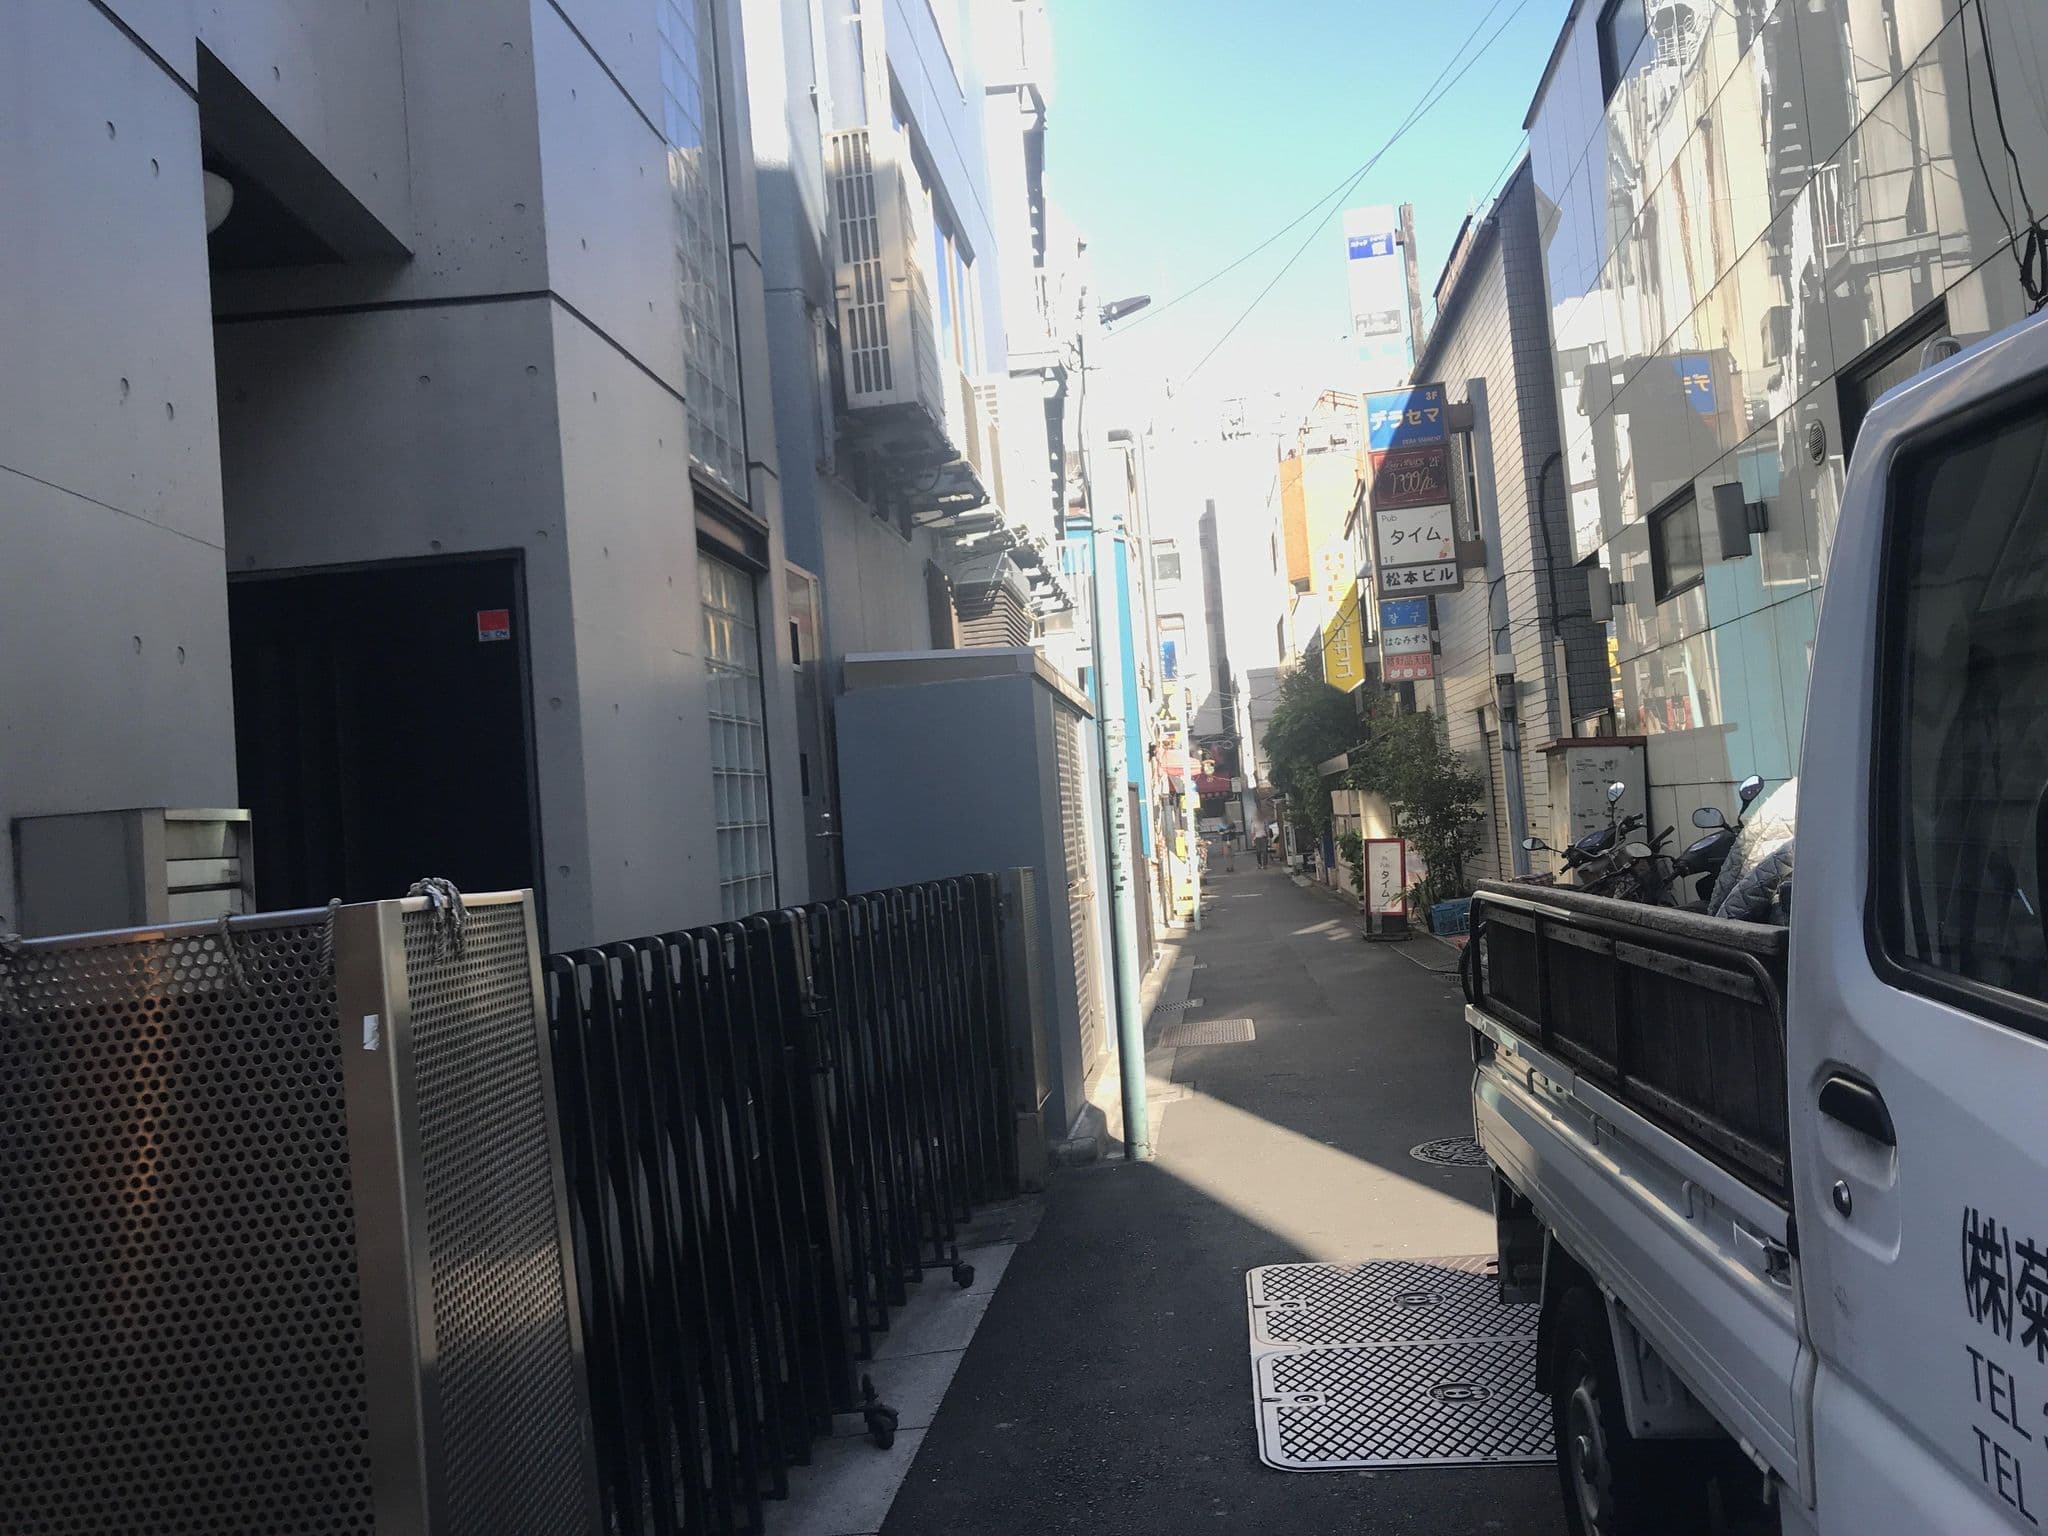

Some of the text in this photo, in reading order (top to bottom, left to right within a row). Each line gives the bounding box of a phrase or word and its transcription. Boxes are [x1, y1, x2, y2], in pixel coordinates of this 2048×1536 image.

[1425, 391, 1438, 400] 3F
[1429, 456, 1440, 467] 2F
[1381, 514, 1398, 522] Pub
[1390, 526, 1441, 546] タイム
[1384, 555, 1395, 564] 1F
[1386, 567, 1454, 587] 松本ビル
[1386, 633, 1428, 646] はなみずき
[1381, 870, 1390, 898] タイム
[1966, 1344, 2032, 1442] TEL
[1972, 1424, 2038, 1526] TEL
